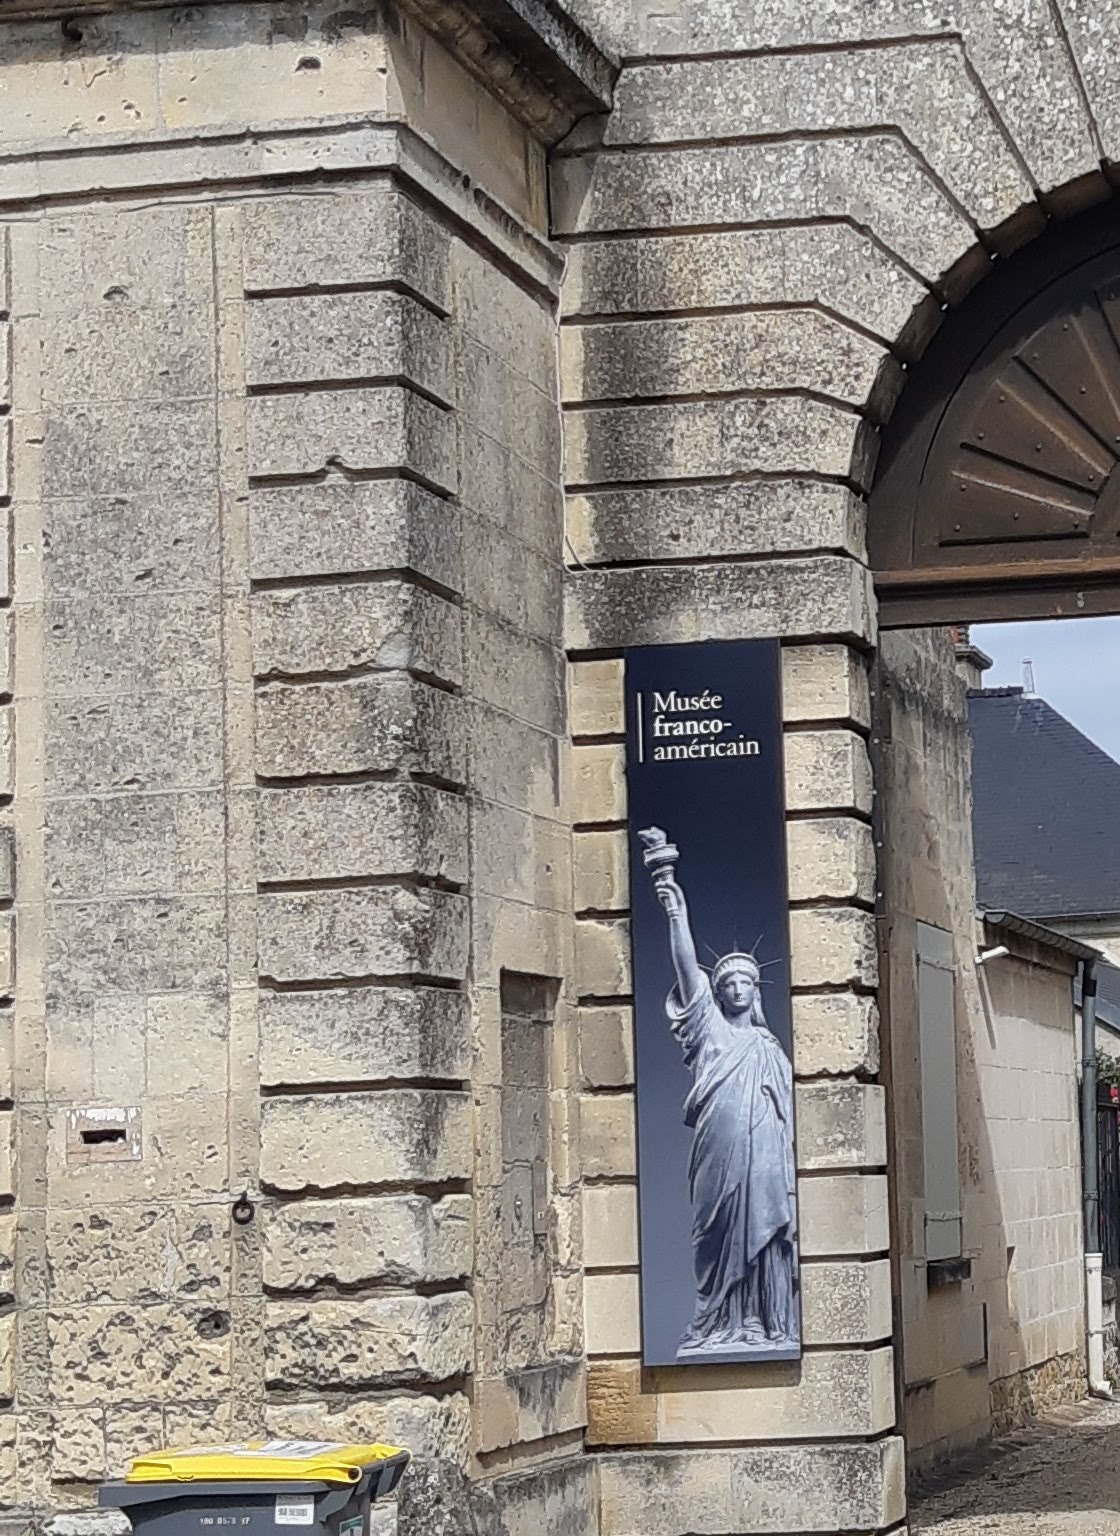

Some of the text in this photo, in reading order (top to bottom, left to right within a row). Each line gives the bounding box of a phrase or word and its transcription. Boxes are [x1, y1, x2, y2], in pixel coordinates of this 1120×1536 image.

[653, 690, 722, 712] Musée
[653, 715, 732, 736] franco-
[653, 735, 760, 760] américain
